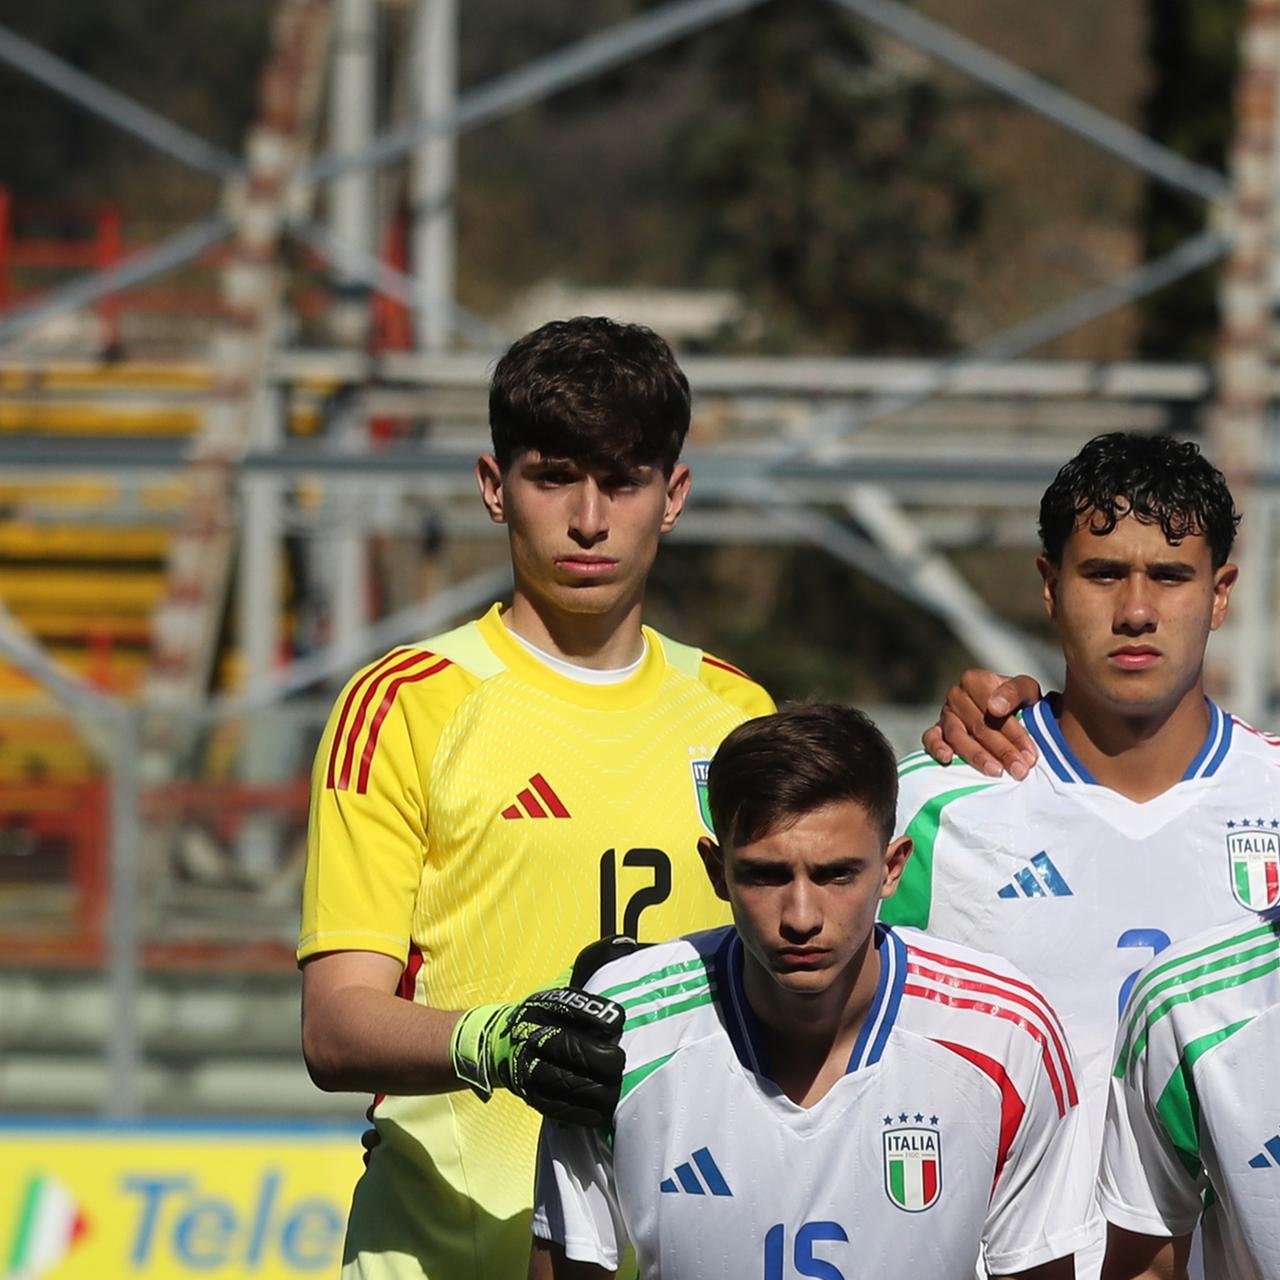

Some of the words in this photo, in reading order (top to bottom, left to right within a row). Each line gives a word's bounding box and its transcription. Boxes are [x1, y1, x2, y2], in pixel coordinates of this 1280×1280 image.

[1231, 838, 1276, 854] ITALIA
[600, 848, 671, 939] 12
[541, 987, 620, 1025] reusch
[888, 1135, 936, 1151] ITALIA
[120, 1164, 344, 1273] Tele
